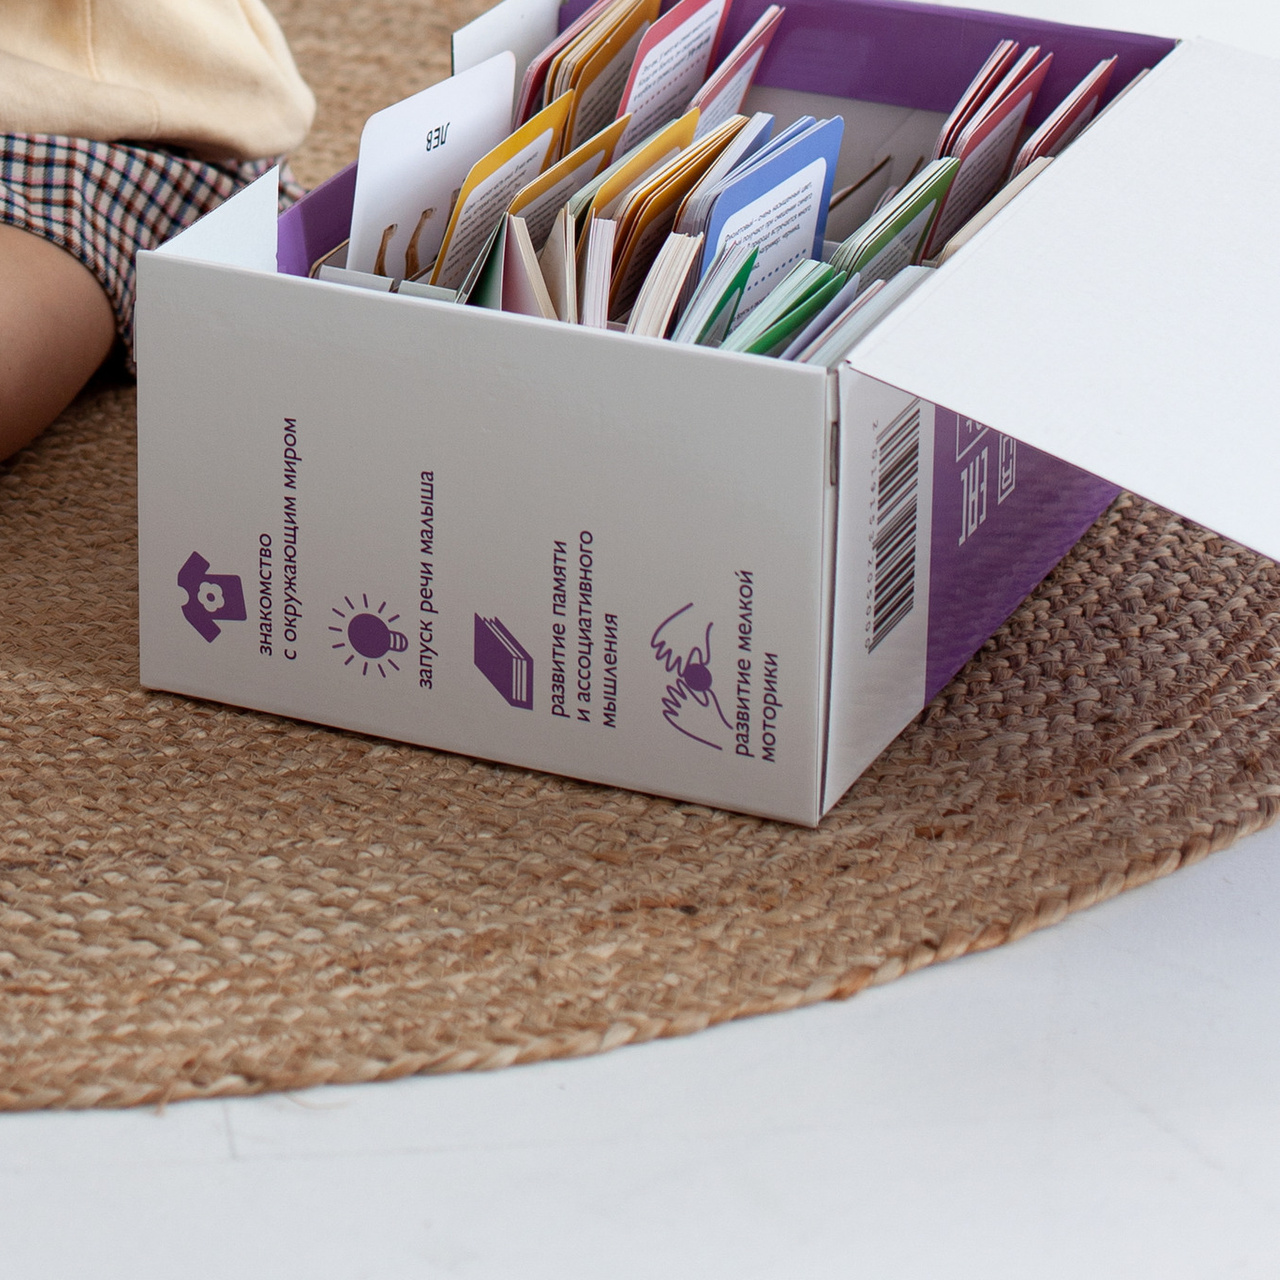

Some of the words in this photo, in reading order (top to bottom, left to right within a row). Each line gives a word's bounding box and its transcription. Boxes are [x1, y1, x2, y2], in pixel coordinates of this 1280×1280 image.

[425, 121, 451, 152] ЛЕВ
[283, 417, 303, 490] миром
[420, 470, 434, 555] малыша
[259, 533, 273, 657] знакомство
[283, 496, 303, 643] окружающим
[419, 561, 439, 614] речи
[552, 540, 567, 617] памяти
[734, 569, 754, 653] мелкой
[283, 648, 297, 661] с
[419, 619, 439, 690] запуск
[577, 530, 595, 704] ассоциативного
[551, 622, 571, 719] развитие
[602, 613, 619, 729] мышления
[735, 657, 756, 759] развитие
[761, 652, 783, 763] моторики
[577, 708, 591, 723] и
